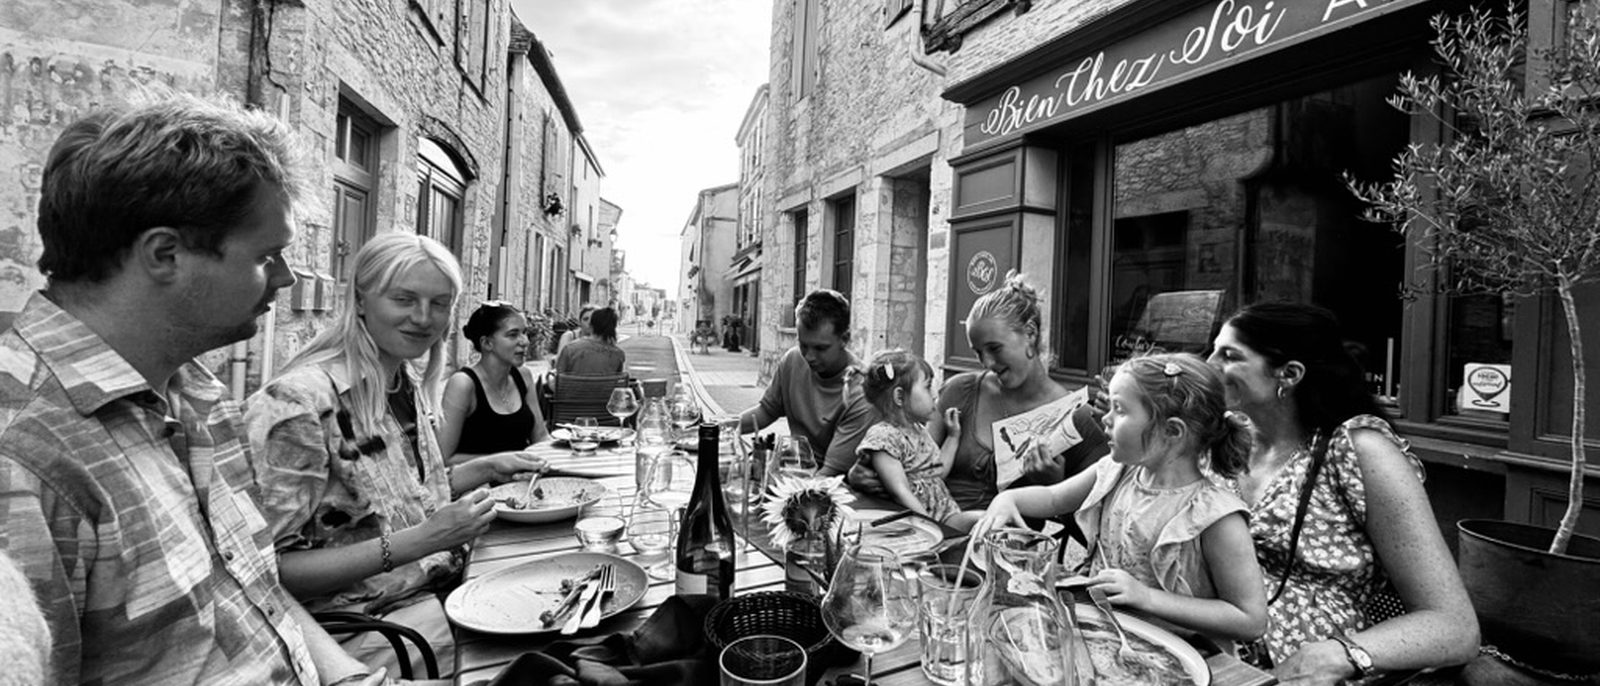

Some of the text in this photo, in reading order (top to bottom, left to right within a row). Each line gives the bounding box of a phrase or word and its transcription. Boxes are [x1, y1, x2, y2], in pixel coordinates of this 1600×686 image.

[981, 86, 1063, 135] Bien
[1056, 52, 1165, 106] Chez
[1170, 0, 1287, 64] Soi
